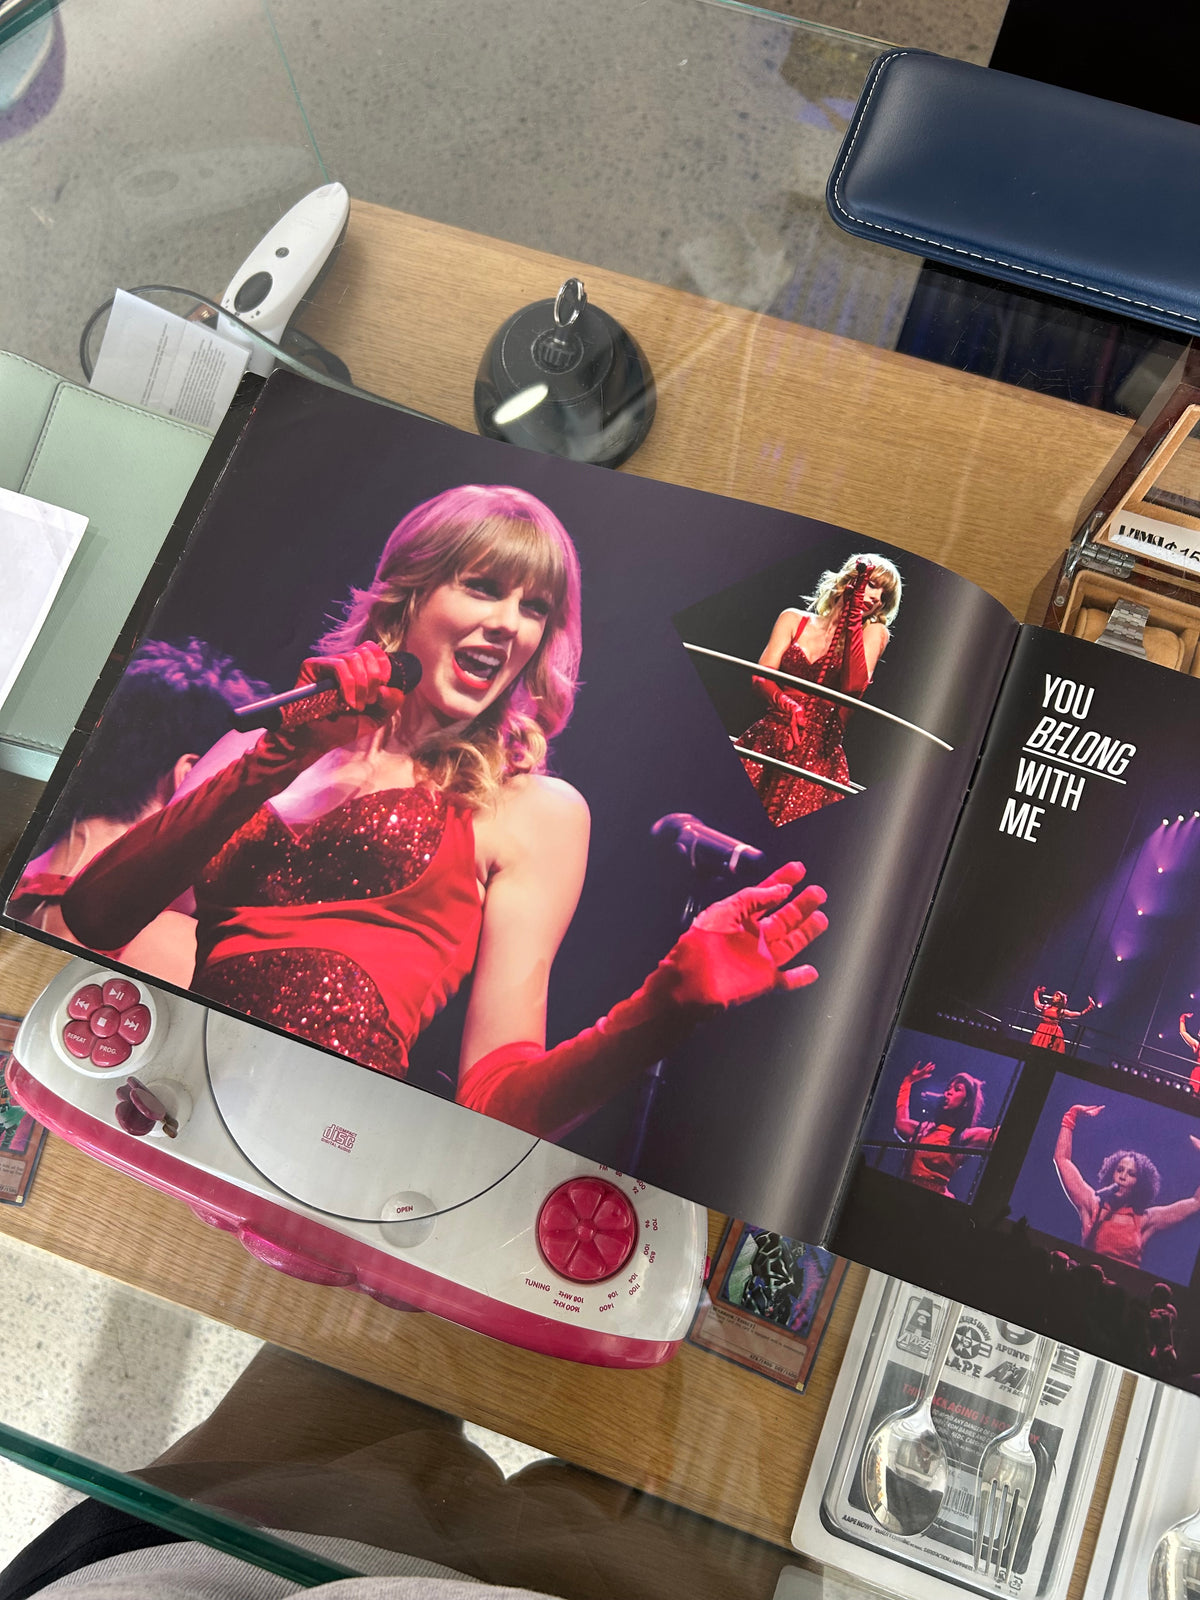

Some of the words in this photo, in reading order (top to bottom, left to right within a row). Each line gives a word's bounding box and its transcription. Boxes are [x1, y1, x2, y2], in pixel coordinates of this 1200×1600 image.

[1042, 674, 1095, 720] YOU
[1025, 715, 1137, 776] BELONG
[1015, 757, 1086, 811] WITH
[999, 797, 1046, 843] ME
[67, 1032, 86, 1043] REPEAT
[100, 1044, 117, 1055] PROG.
[335, 1126, 358, 1137] COMPACT
[320, 1137, 337, 1148] DIGITAL
[337, 1143, 352, 1153] AUDIO
[396, 1205, 414, 1214] OPEN
[628, 1272, 639, 1284] 104
[524, 1278, 551, 1292] TUNING
[628, 1283, 641, 1296] 1100
[558, 1290, 573, 1300] MHz
[573, 1295, 584, 1304] 108
[607, 1290, 619, 1299] 106
[565, 1304, 581, 1313] 1600
[599, 1303, 615, 1312] 1400
[946, 1357, 983, 1378] APE
[931, 1394, 979, 1420] ACKAGING
[979, 1413, 990, 1425] IS
